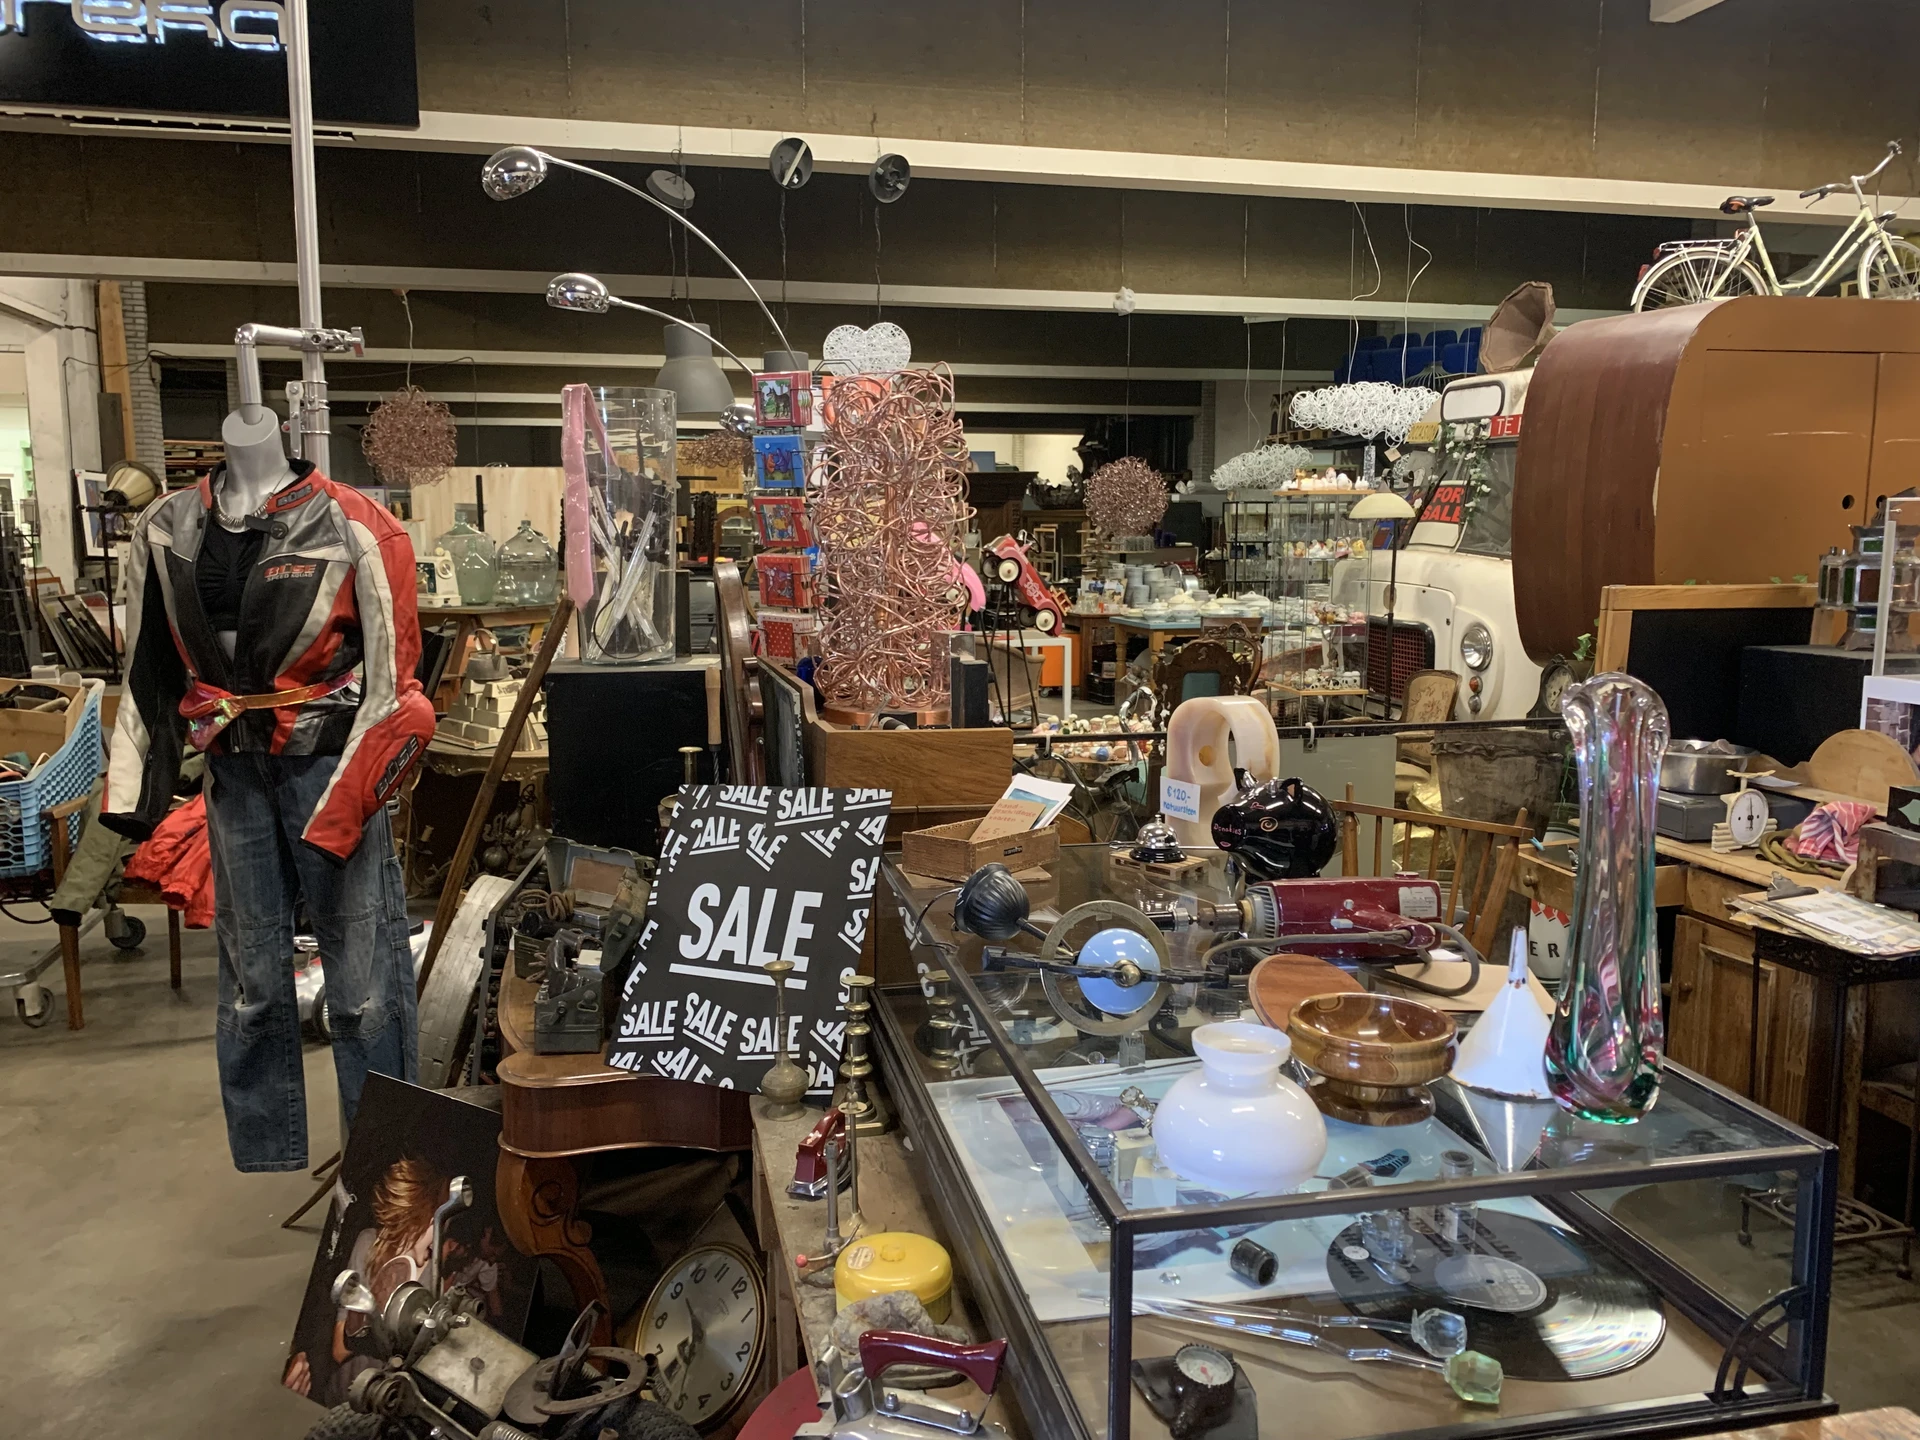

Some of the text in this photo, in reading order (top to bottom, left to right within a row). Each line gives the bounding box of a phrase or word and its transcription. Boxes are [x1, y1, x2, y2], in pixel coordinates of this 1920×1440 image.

[1496, 416, 1513, 435] TE
[1433, 487, 1465, 503] FOR
[1420, 505, 1461, 522] SALE
[777, 787, 834, 820] SALE
[679, 883, 824, 972] SALE
[620, 1000, 679, 1037] SALE
[683, 992, 739, 1049] SALE
[714, 1263, 730, 1283] 11
[670, 1282, 684, 1300] 9
[731, 1276, 748, 1299] 12
[655, 1312, 668, 1329] 8
[735, 1341, 751, 1362] 2
[720, 1372, 735, 1391] 3
